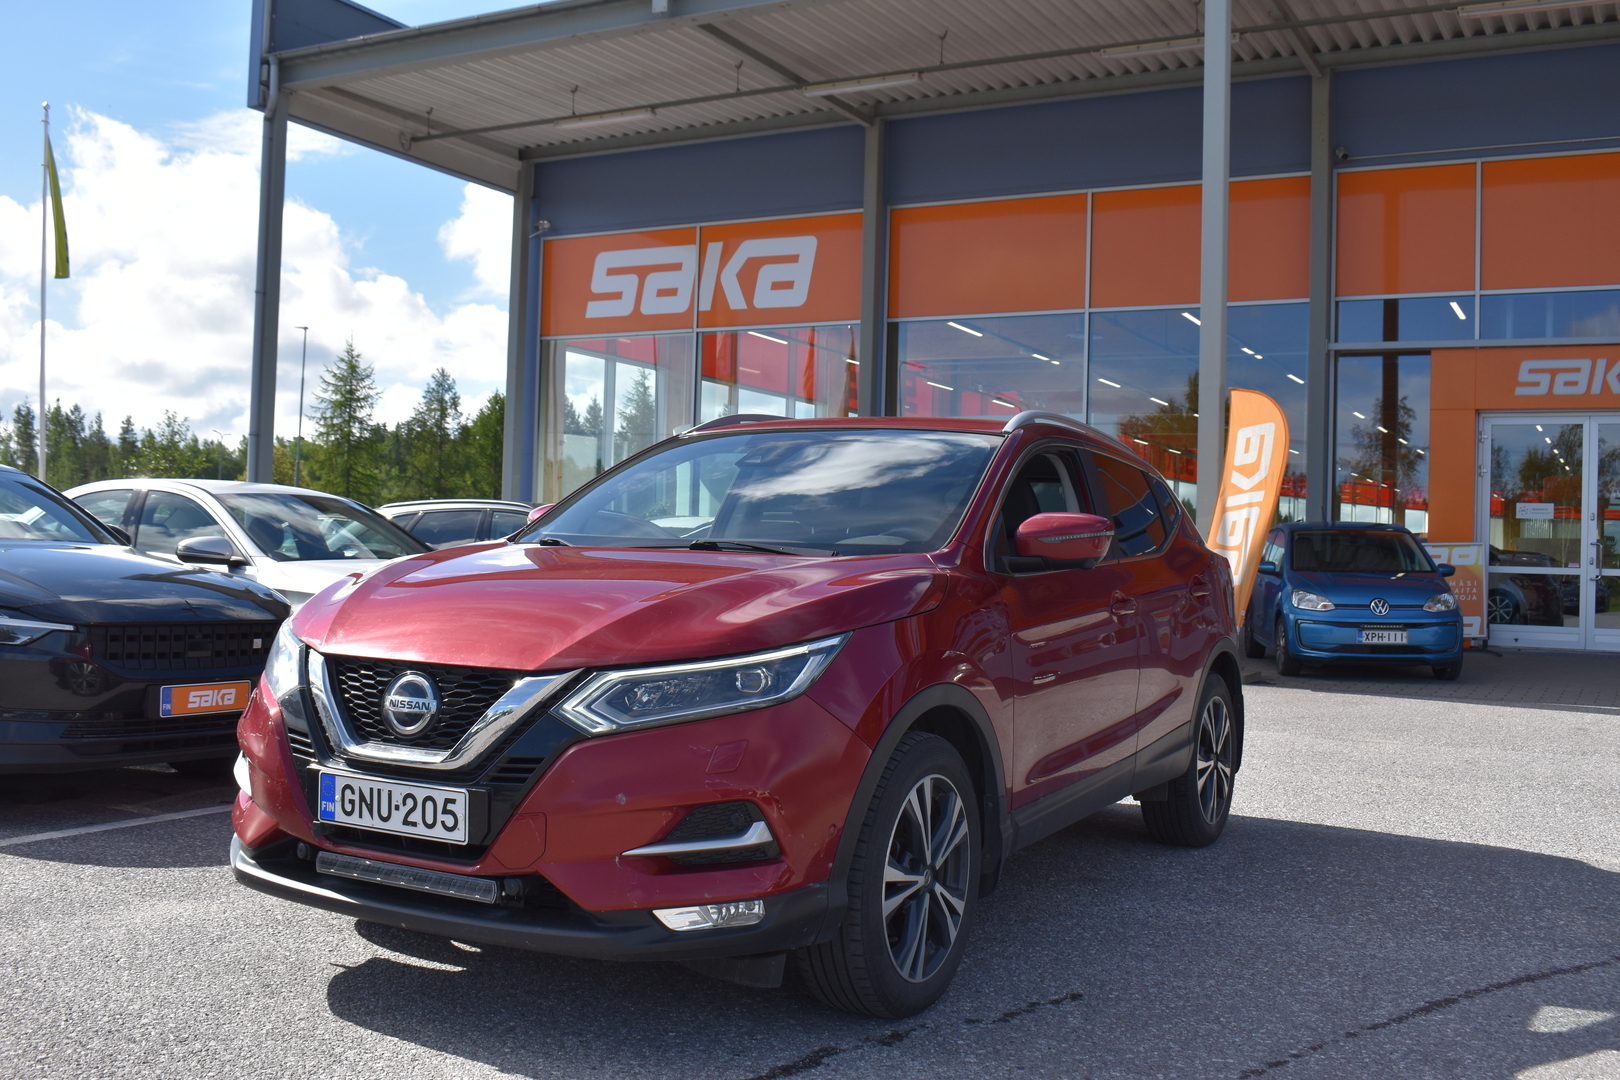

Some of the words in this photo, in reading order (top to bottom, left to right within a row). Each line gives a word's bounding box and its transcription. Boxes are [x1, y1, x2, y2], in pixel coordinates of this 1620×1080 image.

[1514, 358, 1620, 396] sak
[389, 699, 431, 711] NISSAN
[321, 800, 335, 813] FIN
